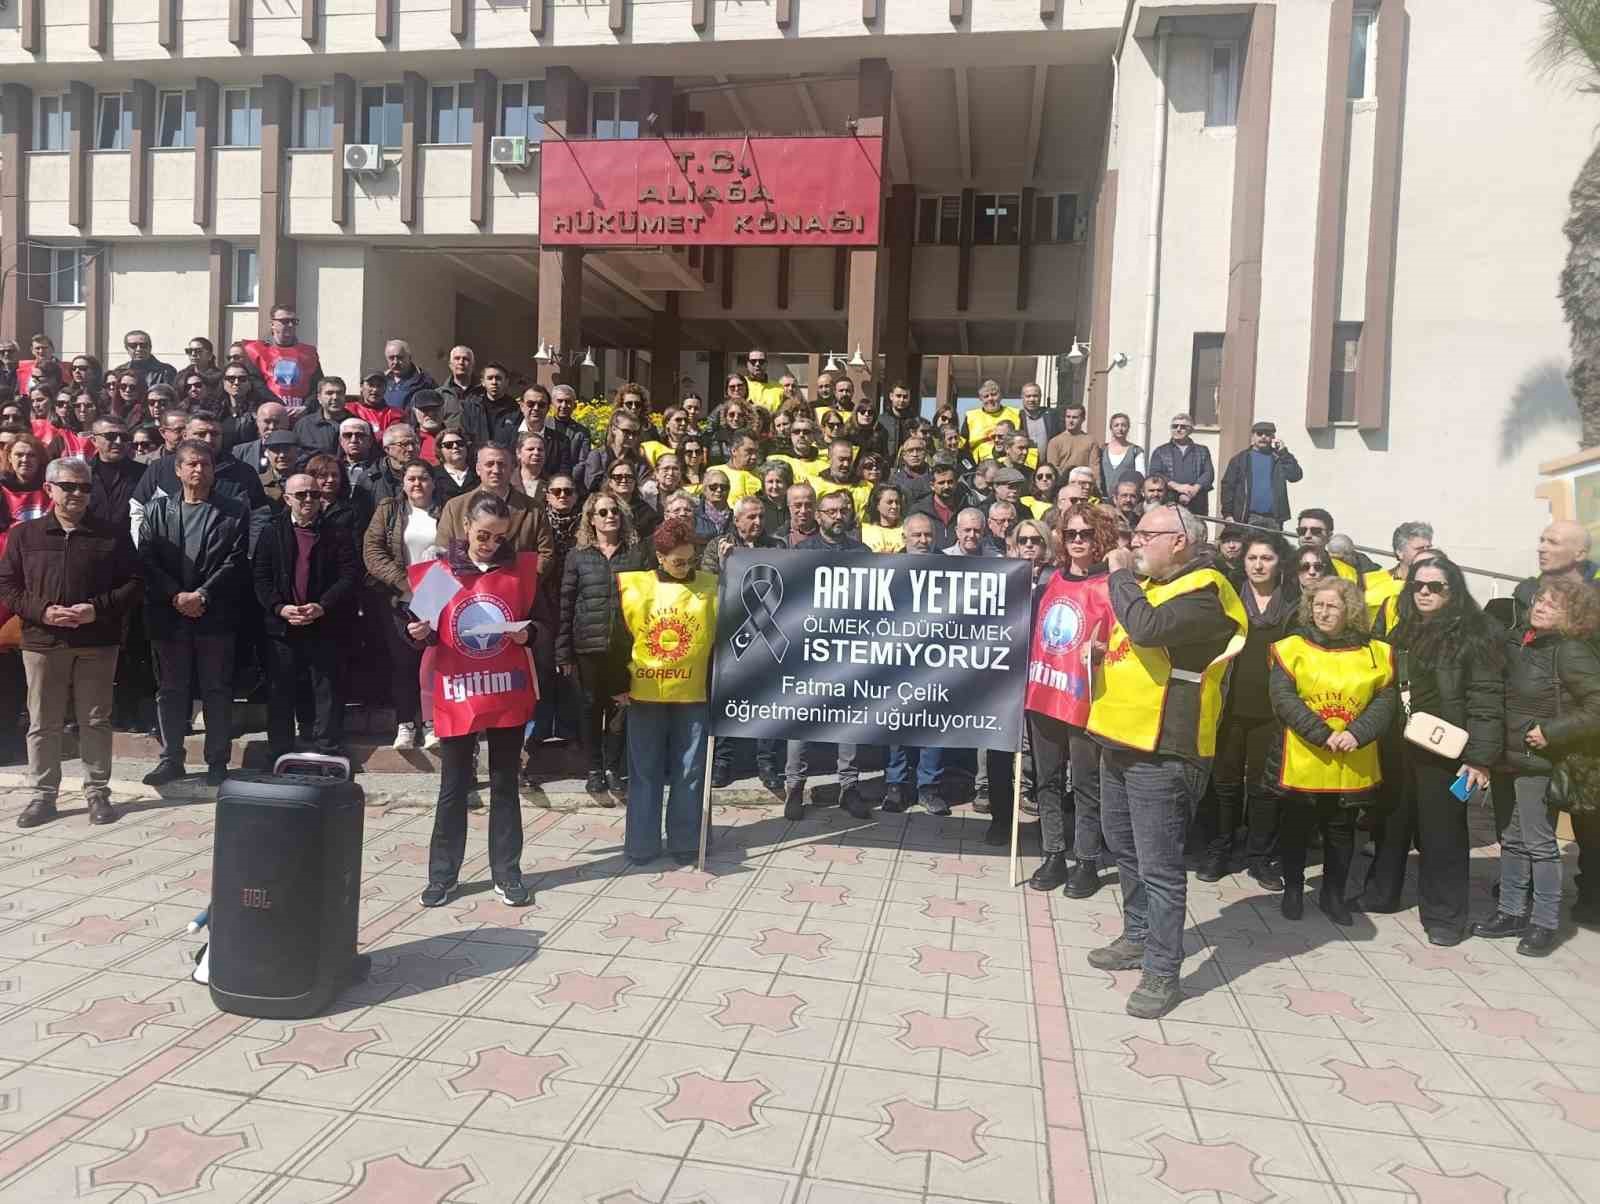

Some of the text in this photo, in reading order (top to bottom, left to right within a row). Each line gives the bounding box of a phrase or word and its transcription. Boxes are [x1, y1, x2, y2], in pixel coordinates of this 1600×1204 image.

[674, 150, 744, 174] T.C.
[638, 180, 774, 204] ALİAĞA
[552, 210, 866, 235] HÜKÜMET KONAĞI
[813, 566, 1006, 616] ARTIK YETER!
[442, 670, 512, 703] Eğitim
[781, 676, 949, 708] Fatma Nur Çelik
[724, 699, 1003, 733] öğretmenimizi uğurluyoruz.
